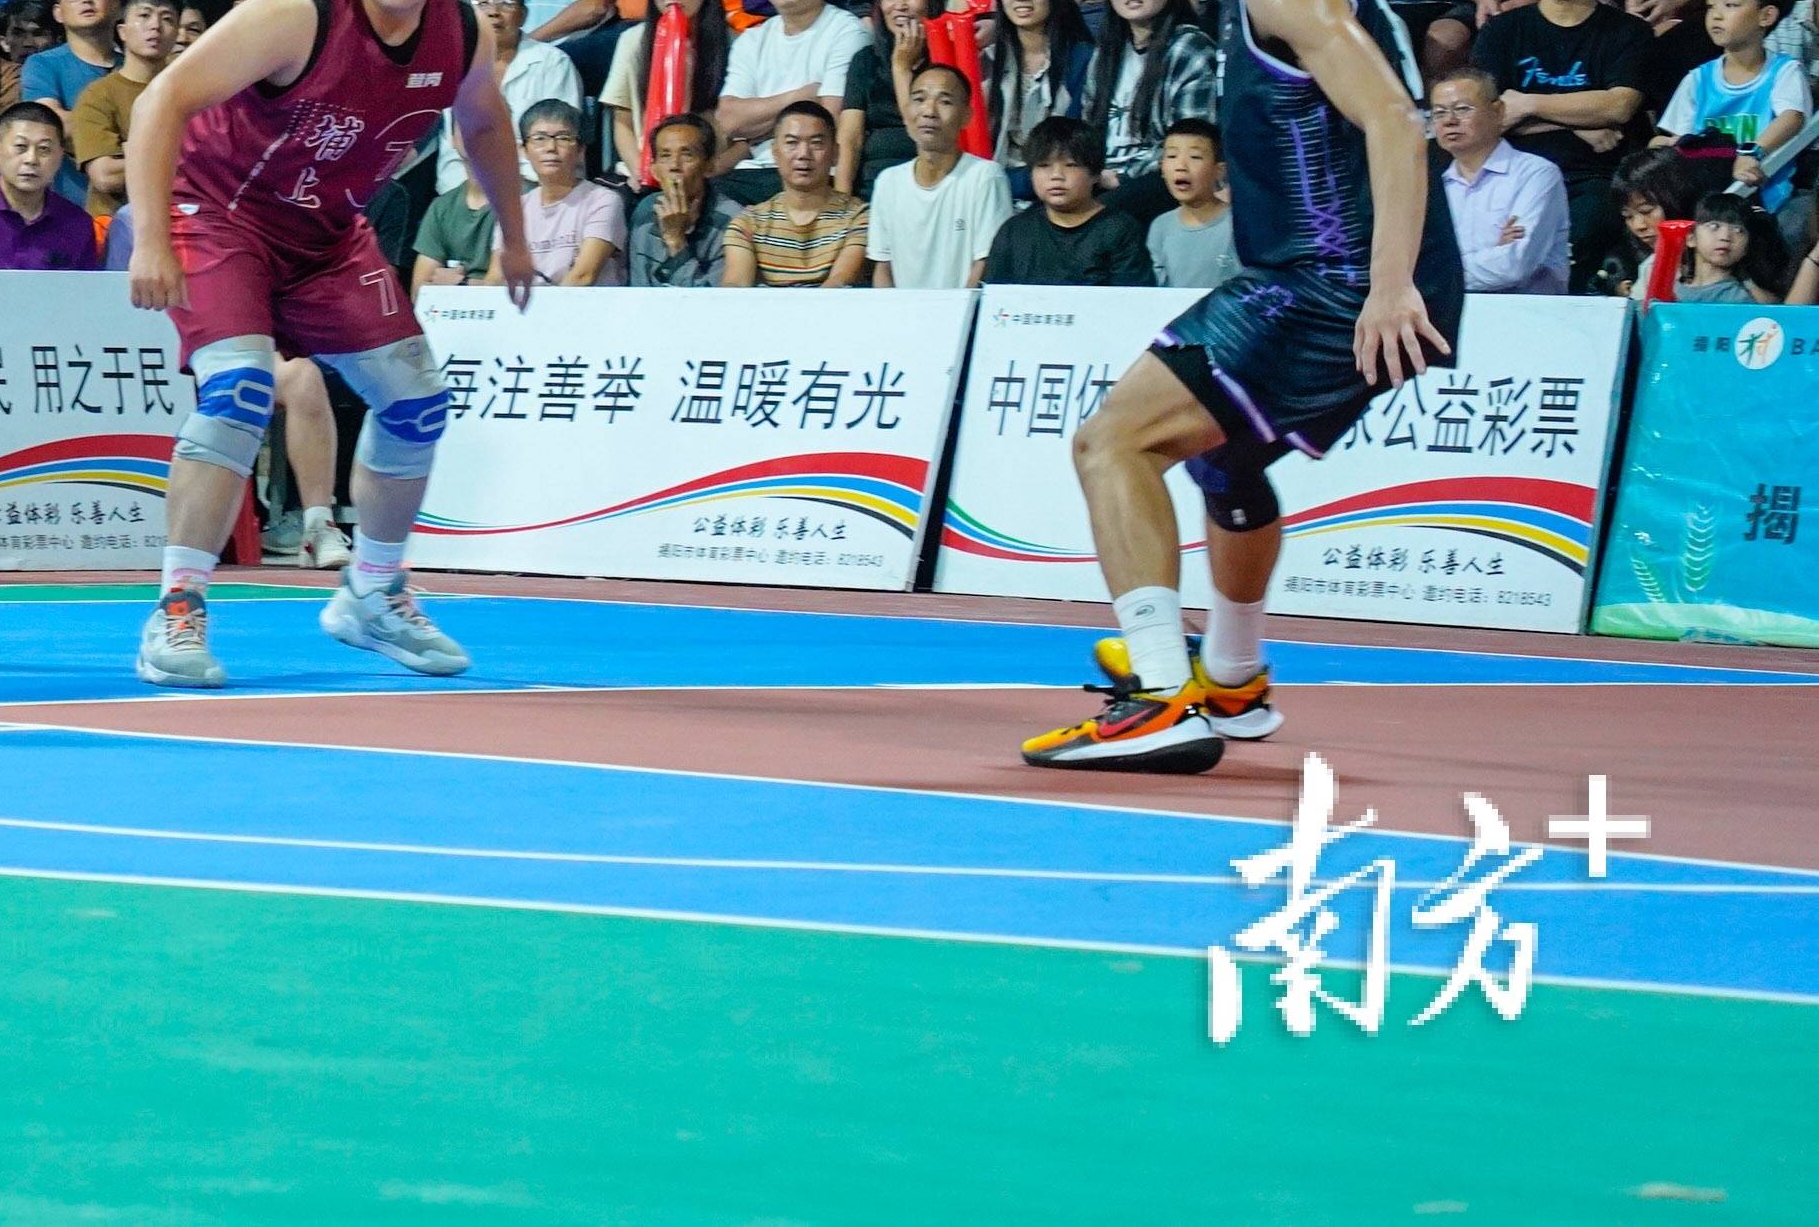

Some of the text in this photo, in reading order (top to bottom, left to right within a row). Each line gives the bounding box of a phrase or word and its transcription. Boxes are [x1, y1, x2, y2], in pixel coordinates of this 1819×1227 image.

[359, 269, 399, 316] 7
[31, 343, 175, 415] 用之于民
[441, 353, 906, 430] 每注善举 温暖有光
[70, 500, 147, 525] 乐善人生
[692, 515, 848, 541] 公益体彩 乐善人生
[1743, 483, 1802, 545] 揭
[1322, 544, 1505, 576] 公益体彩 乐善人生
[1283, 575, 1413, 601] 揭阳市体育彩票中心
